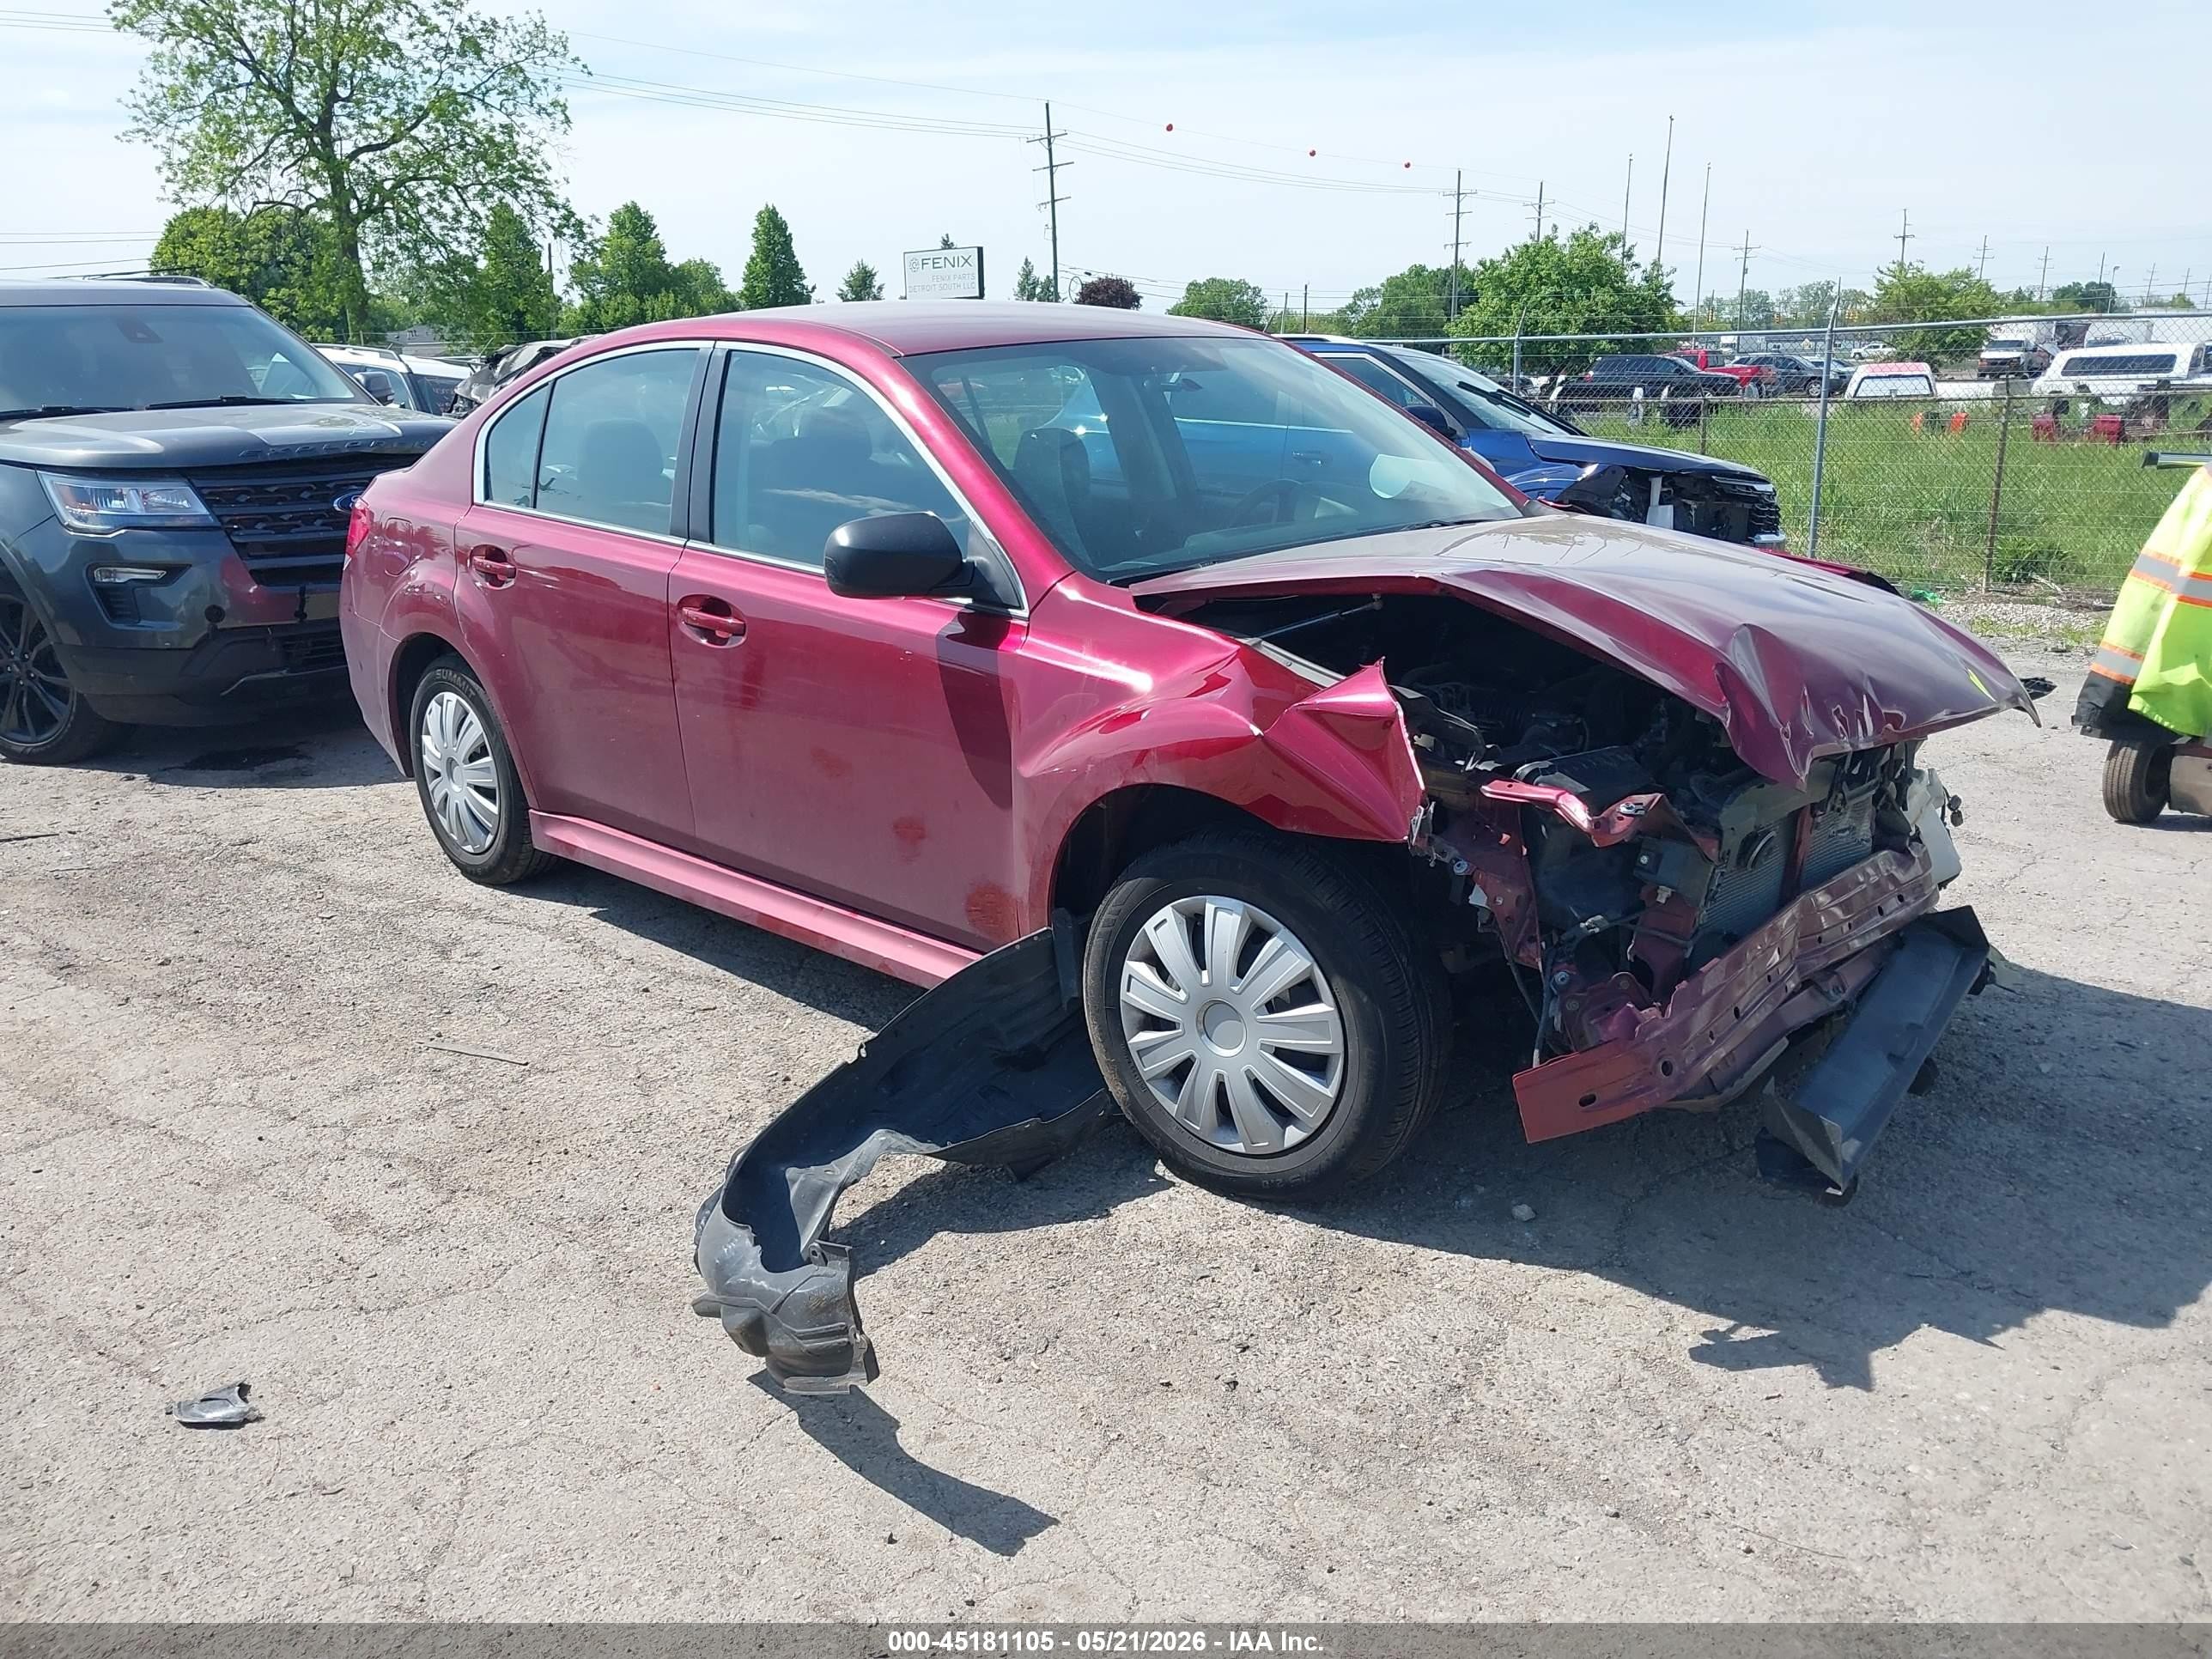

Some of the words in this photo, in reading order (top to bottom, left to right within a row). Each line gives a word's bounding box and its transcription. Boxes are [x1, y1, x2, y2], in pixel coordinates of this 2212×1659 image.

[921, 255, 973, 270] FENIX
[939, 283, 961, 291] SOUTH
[238, 440, 429, 459] EXPLORER
[435, 669, 476, 697] SUMMIT
